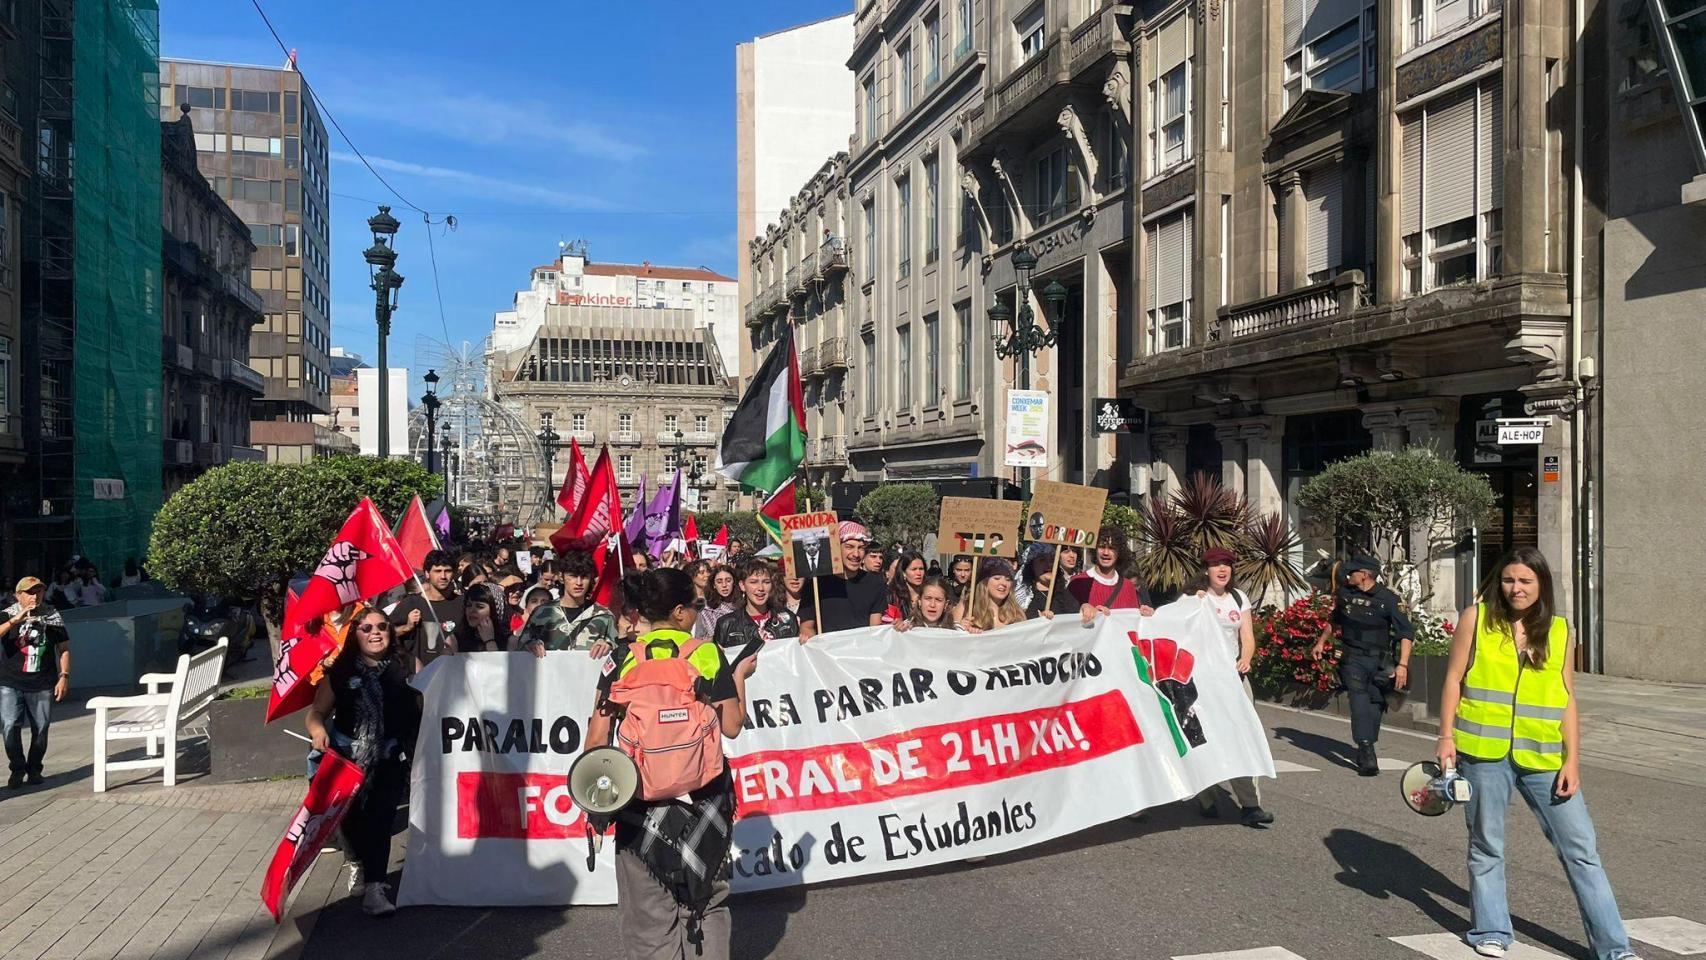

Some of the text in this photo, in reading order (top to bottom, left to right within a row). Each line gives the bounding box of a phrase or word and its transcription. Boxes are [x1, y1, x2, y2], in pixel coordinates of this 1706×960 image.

[1501, 430, 1541, 441] ALE-HOP
[782, 513, 837, 531] XENOCIDA
[1045, 525, 1095, 545] OPRIMIDO
[441, 715, 581, 755] PARALO
[814, 667, 938, 723] PARAR
[946, 668, 977, 696] O
[660, 711, 687, 719] HUNTER
[732, 752, 862, 803] ERAL
[870, 738, 928, 786] DE
[940, 722, 1020, 775] 24H
[1029, 710, 1091, 756] XA!
[823, 821, 867, 865] de
[877, 797, 1037, 862] Estudantes
